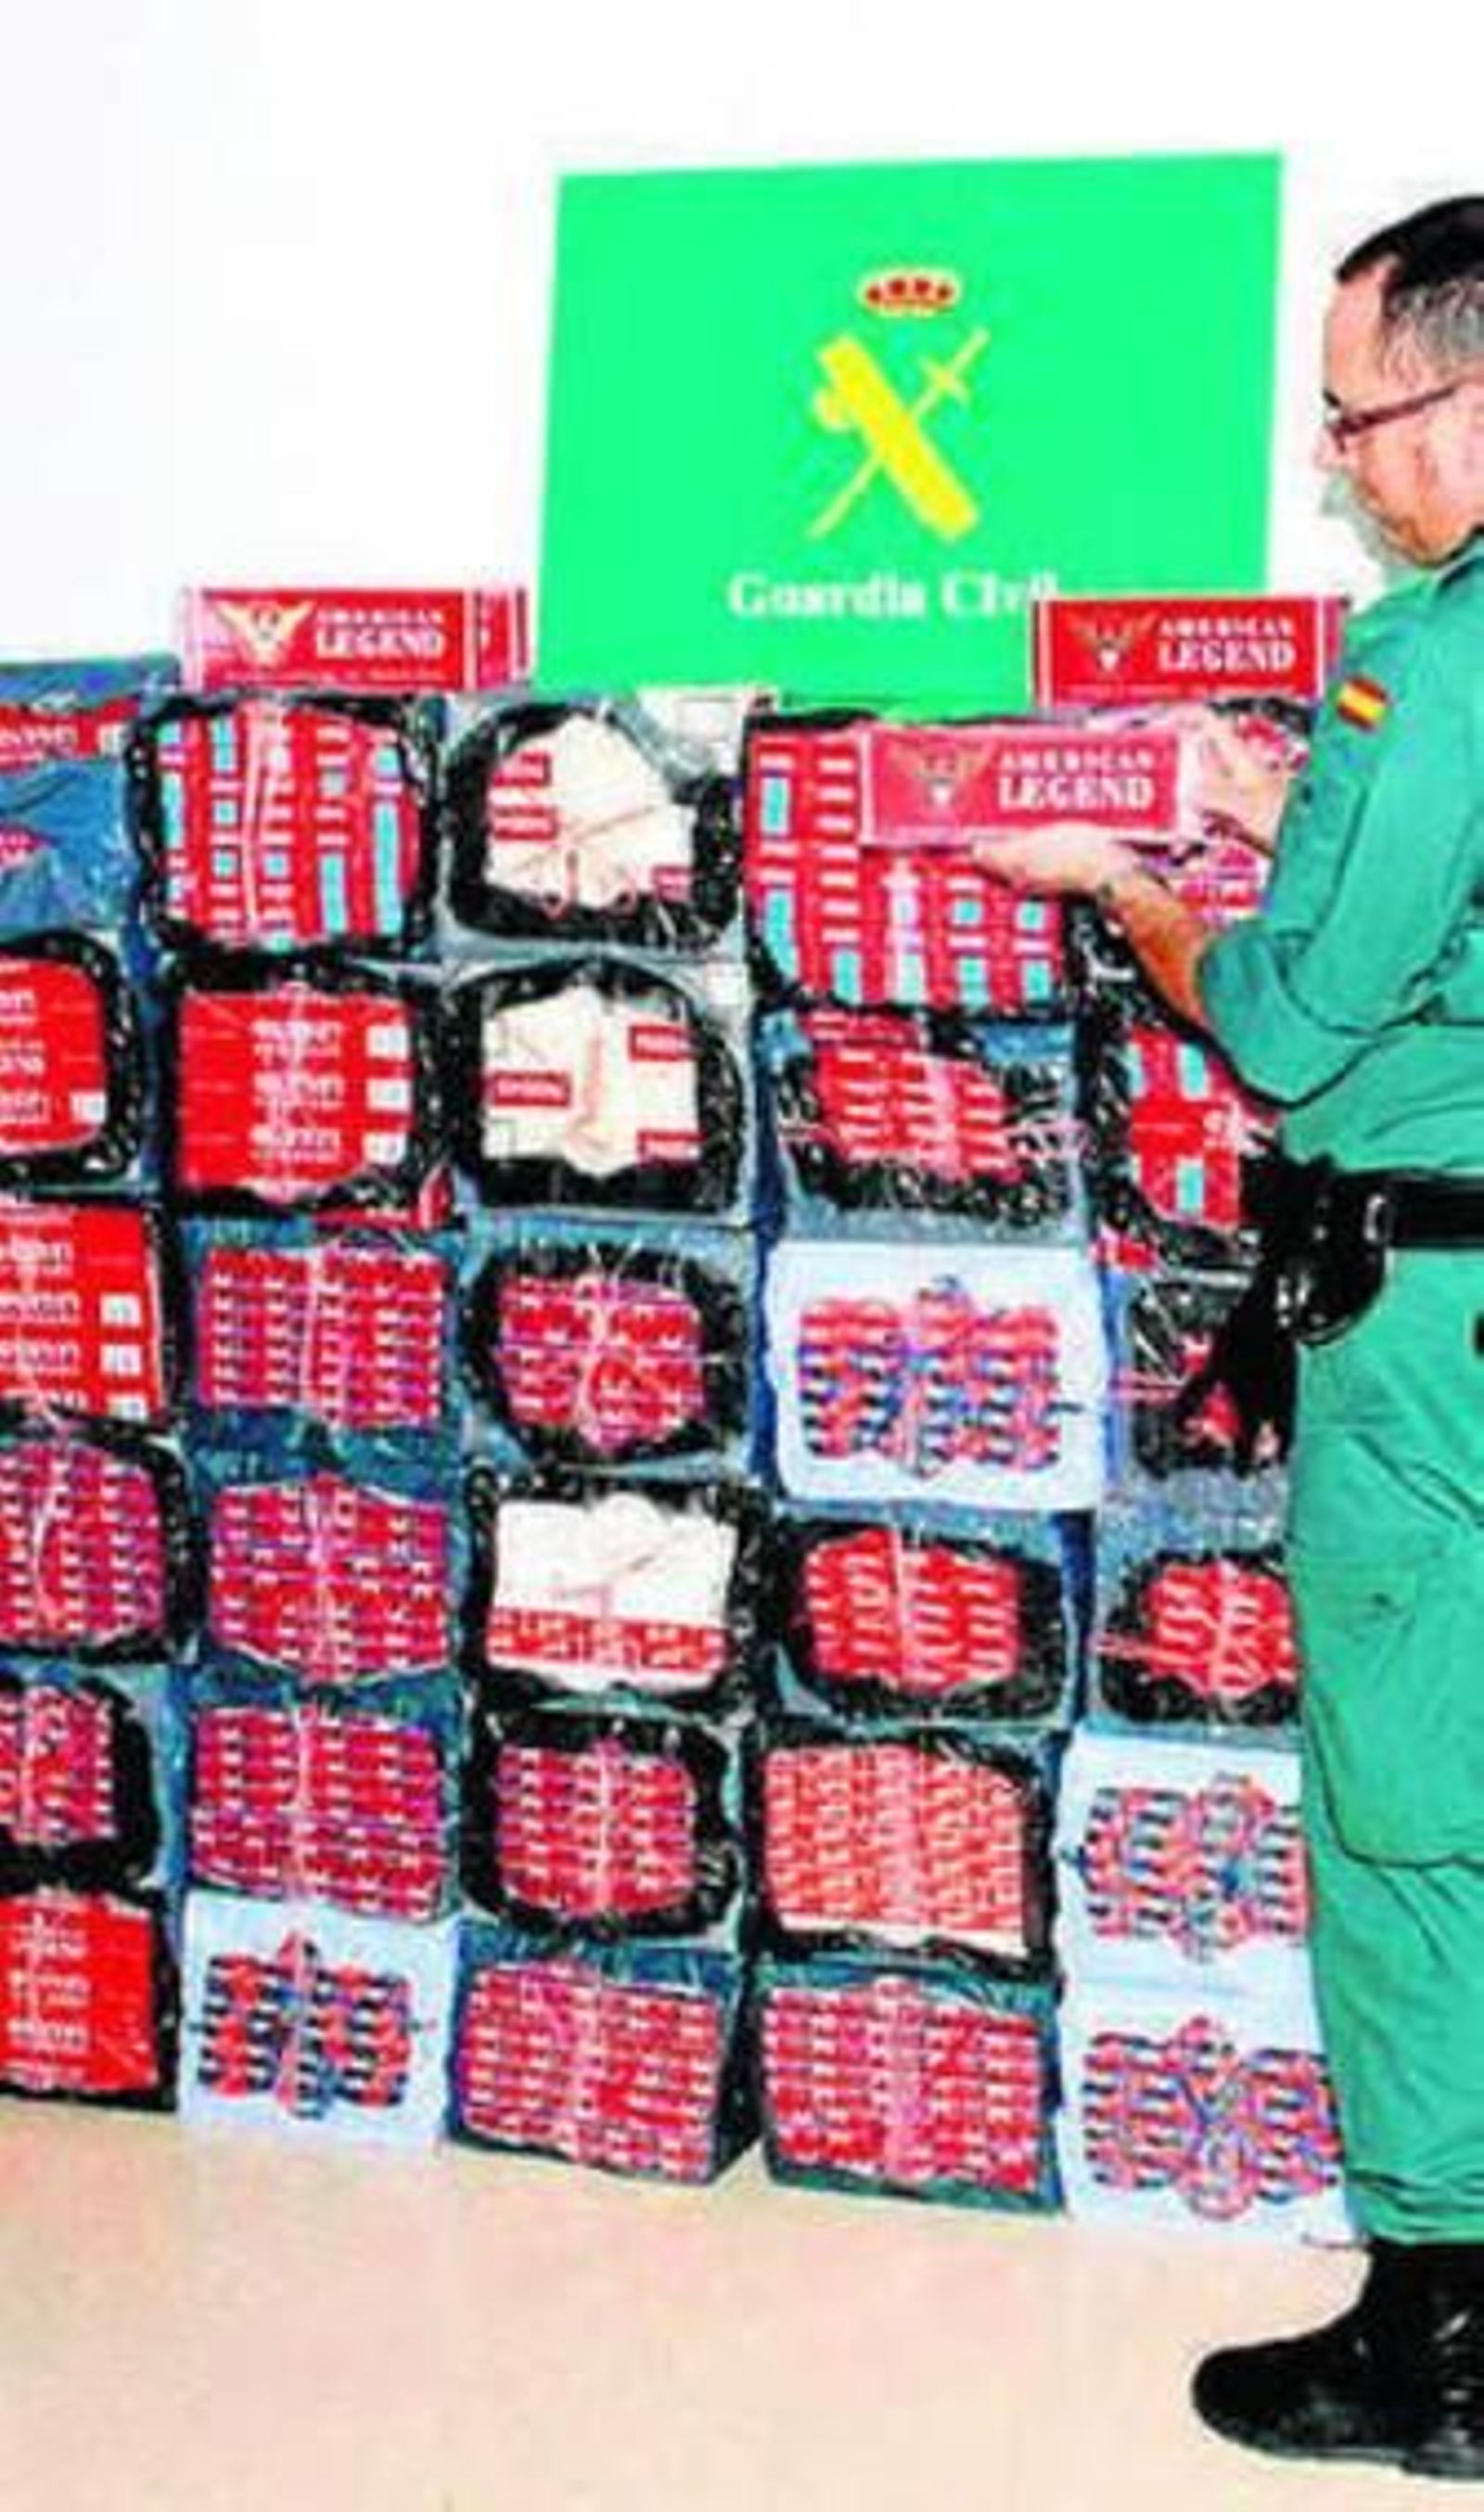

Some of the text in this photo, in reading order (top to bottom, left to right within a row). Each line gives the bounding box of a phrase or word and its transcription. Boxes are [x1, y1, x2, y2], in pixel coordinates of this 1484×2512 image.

[727, 567, 927, 617] Guardia
[315, 628, 443, 660] LEGEND
[1158, 640, 1297, 673] LEGEND
[998, 776, 1156, 812] LEGEND
